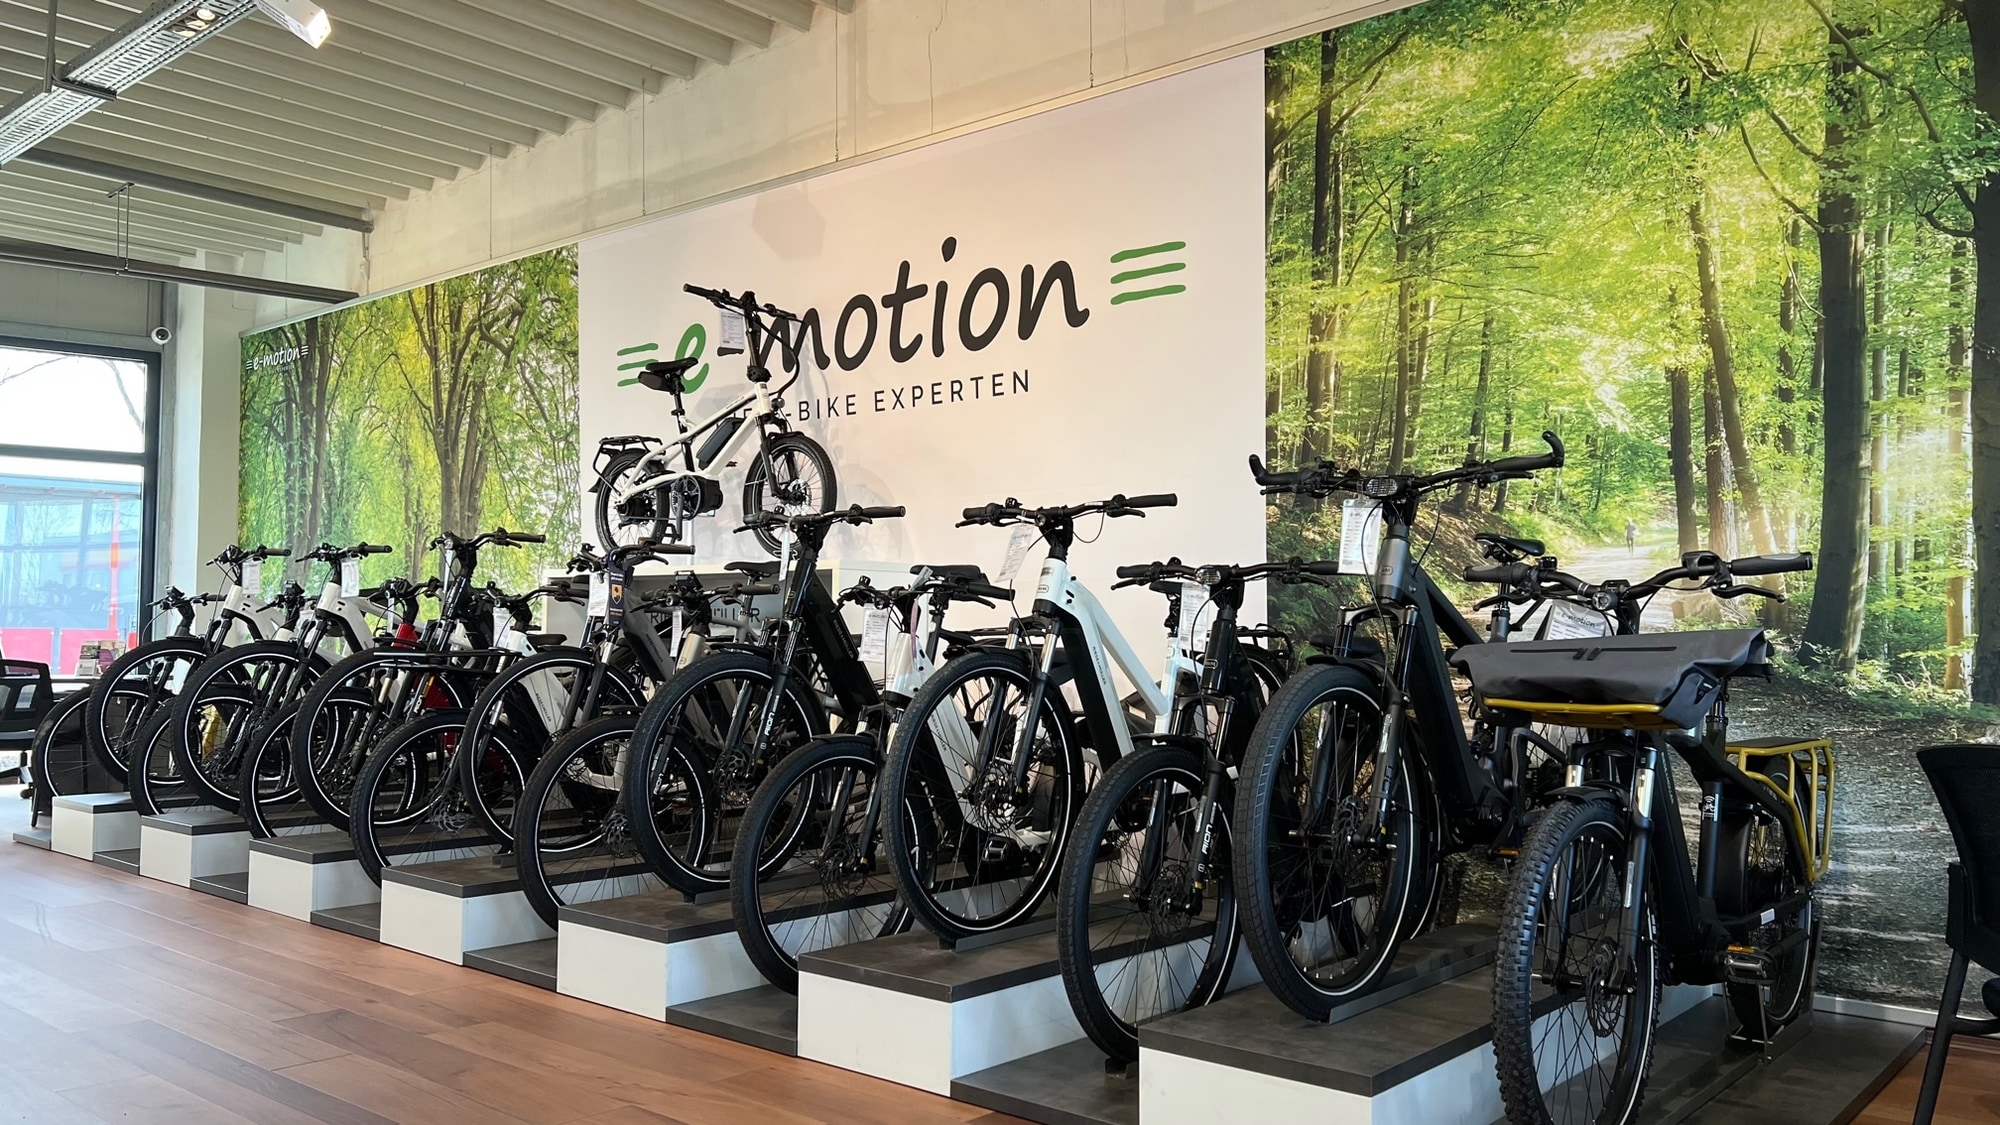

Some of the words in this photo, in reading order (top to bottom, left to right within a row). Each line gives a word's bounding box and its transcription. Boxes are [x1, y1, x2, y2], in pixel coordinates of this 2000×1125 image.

[675, 237, 1089, 393] e-motion
[253, 343, 300, 371] e-motion
[785, 394, 857, 421] -BIKE
[875, 370, 1029, 411] EXPERTEN
